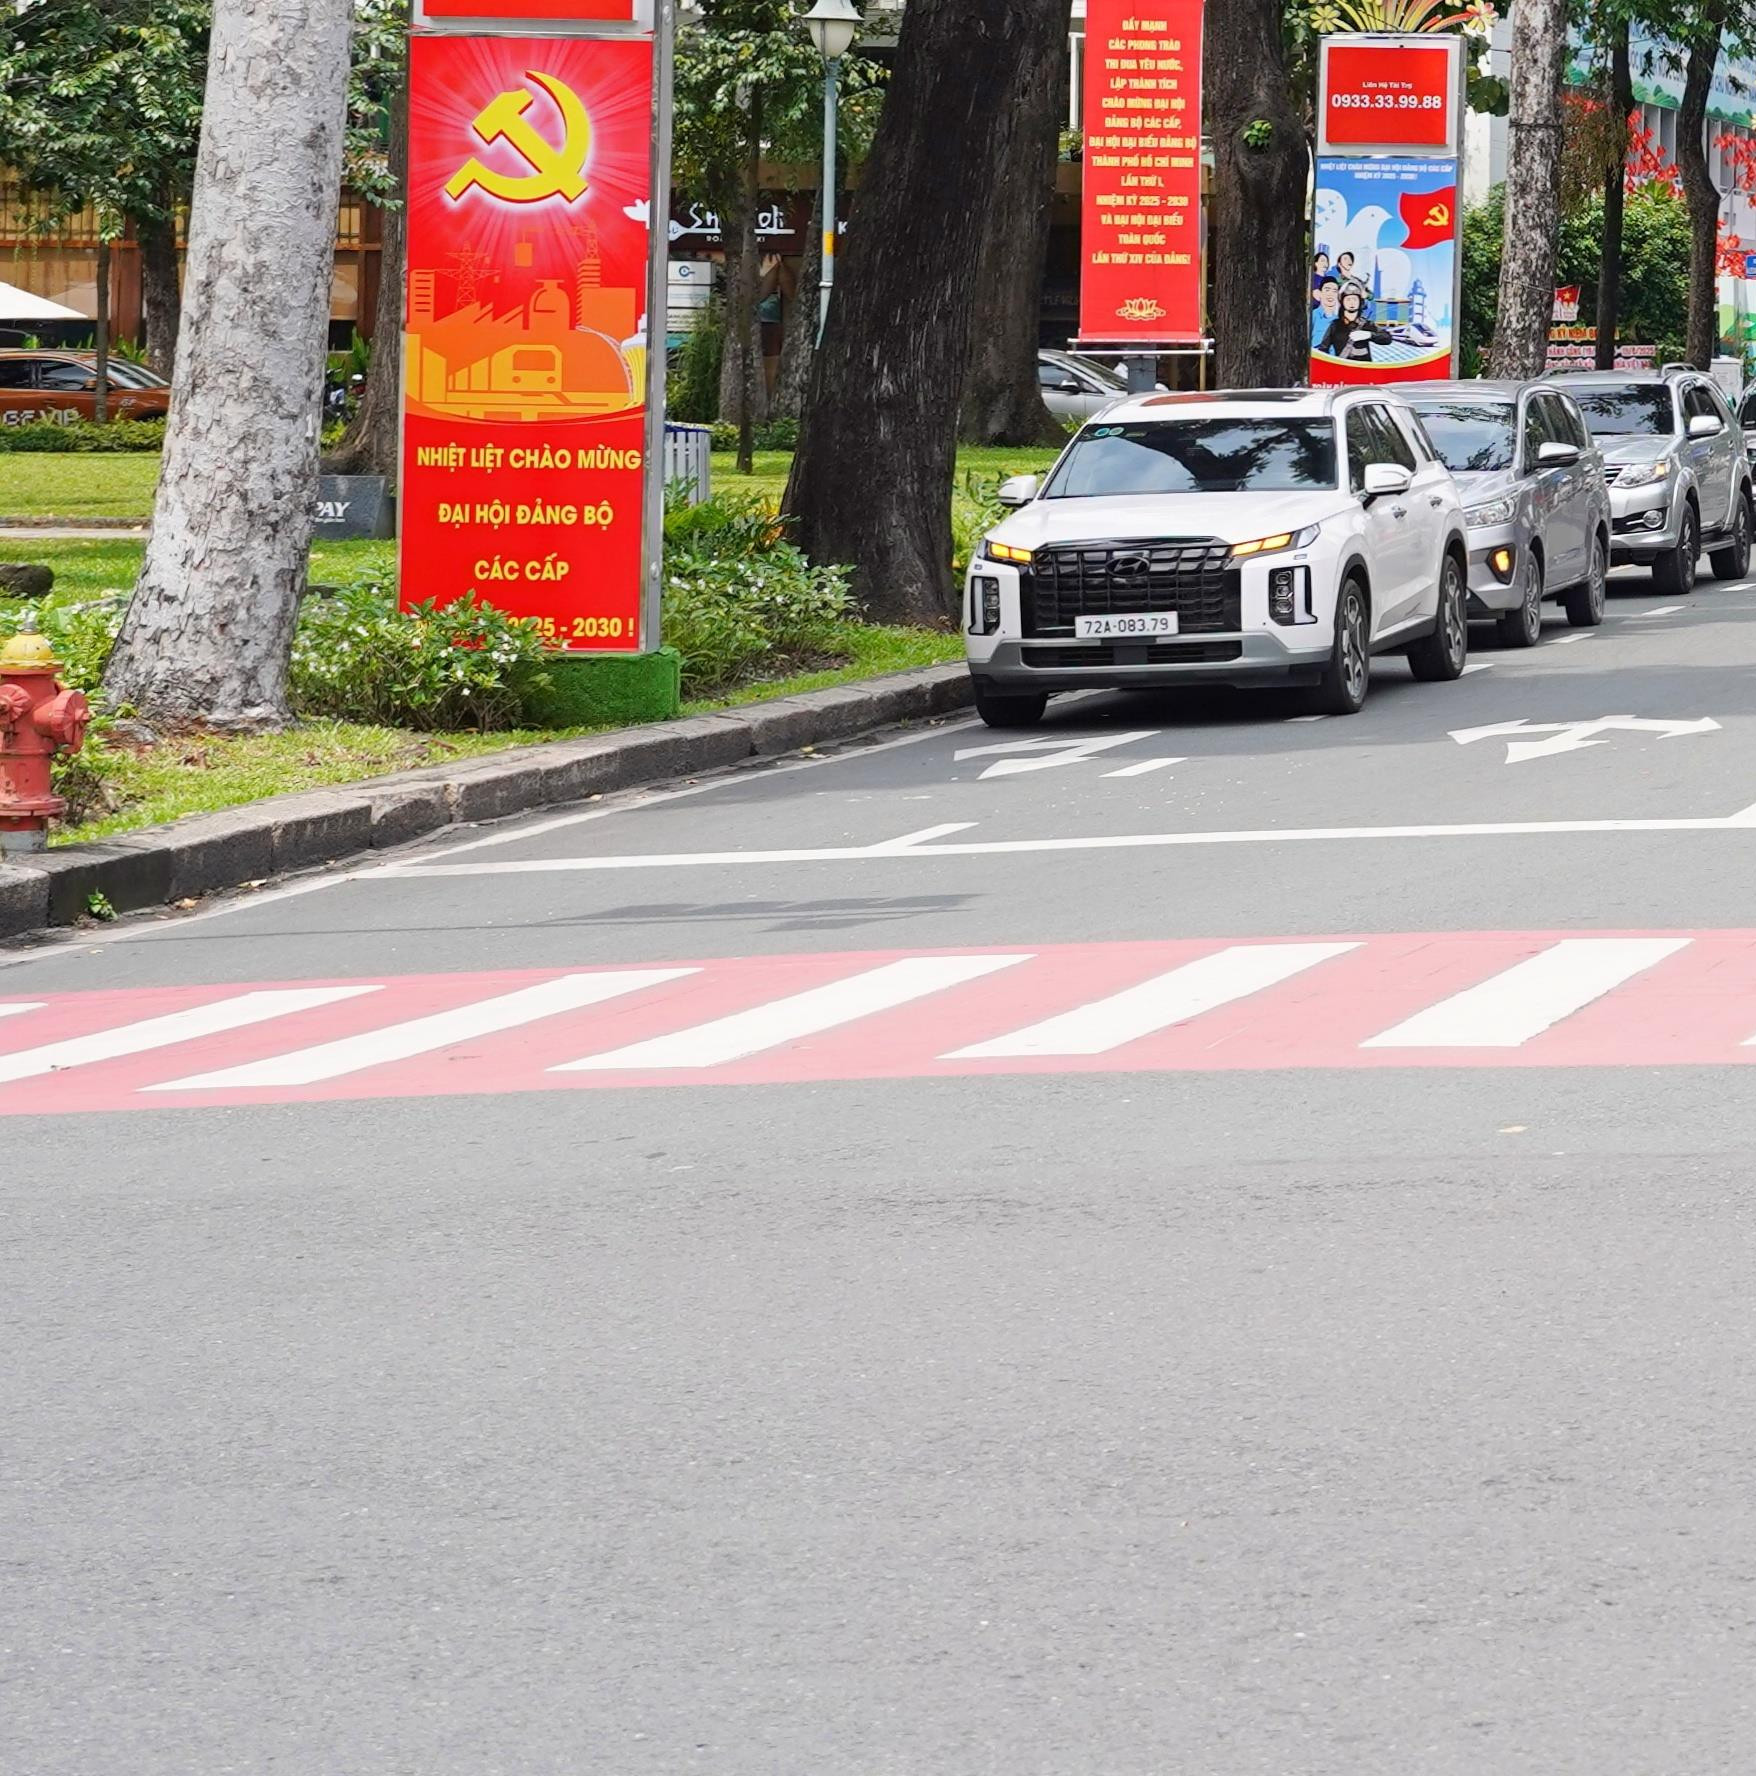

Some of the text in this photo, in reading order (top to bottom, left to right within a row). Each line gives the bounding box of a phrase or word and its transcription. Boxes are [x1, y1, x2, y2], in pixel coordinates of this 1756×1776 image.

[1331, 94, 1442, 109] 0933.33.99.88
[416, 442, 642, 474] NHIỆT LIỆT CHÀO MỪNG
[438, 498, 614, 531] ĐẠI HỘI ĐẢNG BỘ
[474, 552, 570, 581] CÁC CẤP
[572, 617, 624, 637] 2030
[1084, 618, 1169, 634] 72A-083.79
